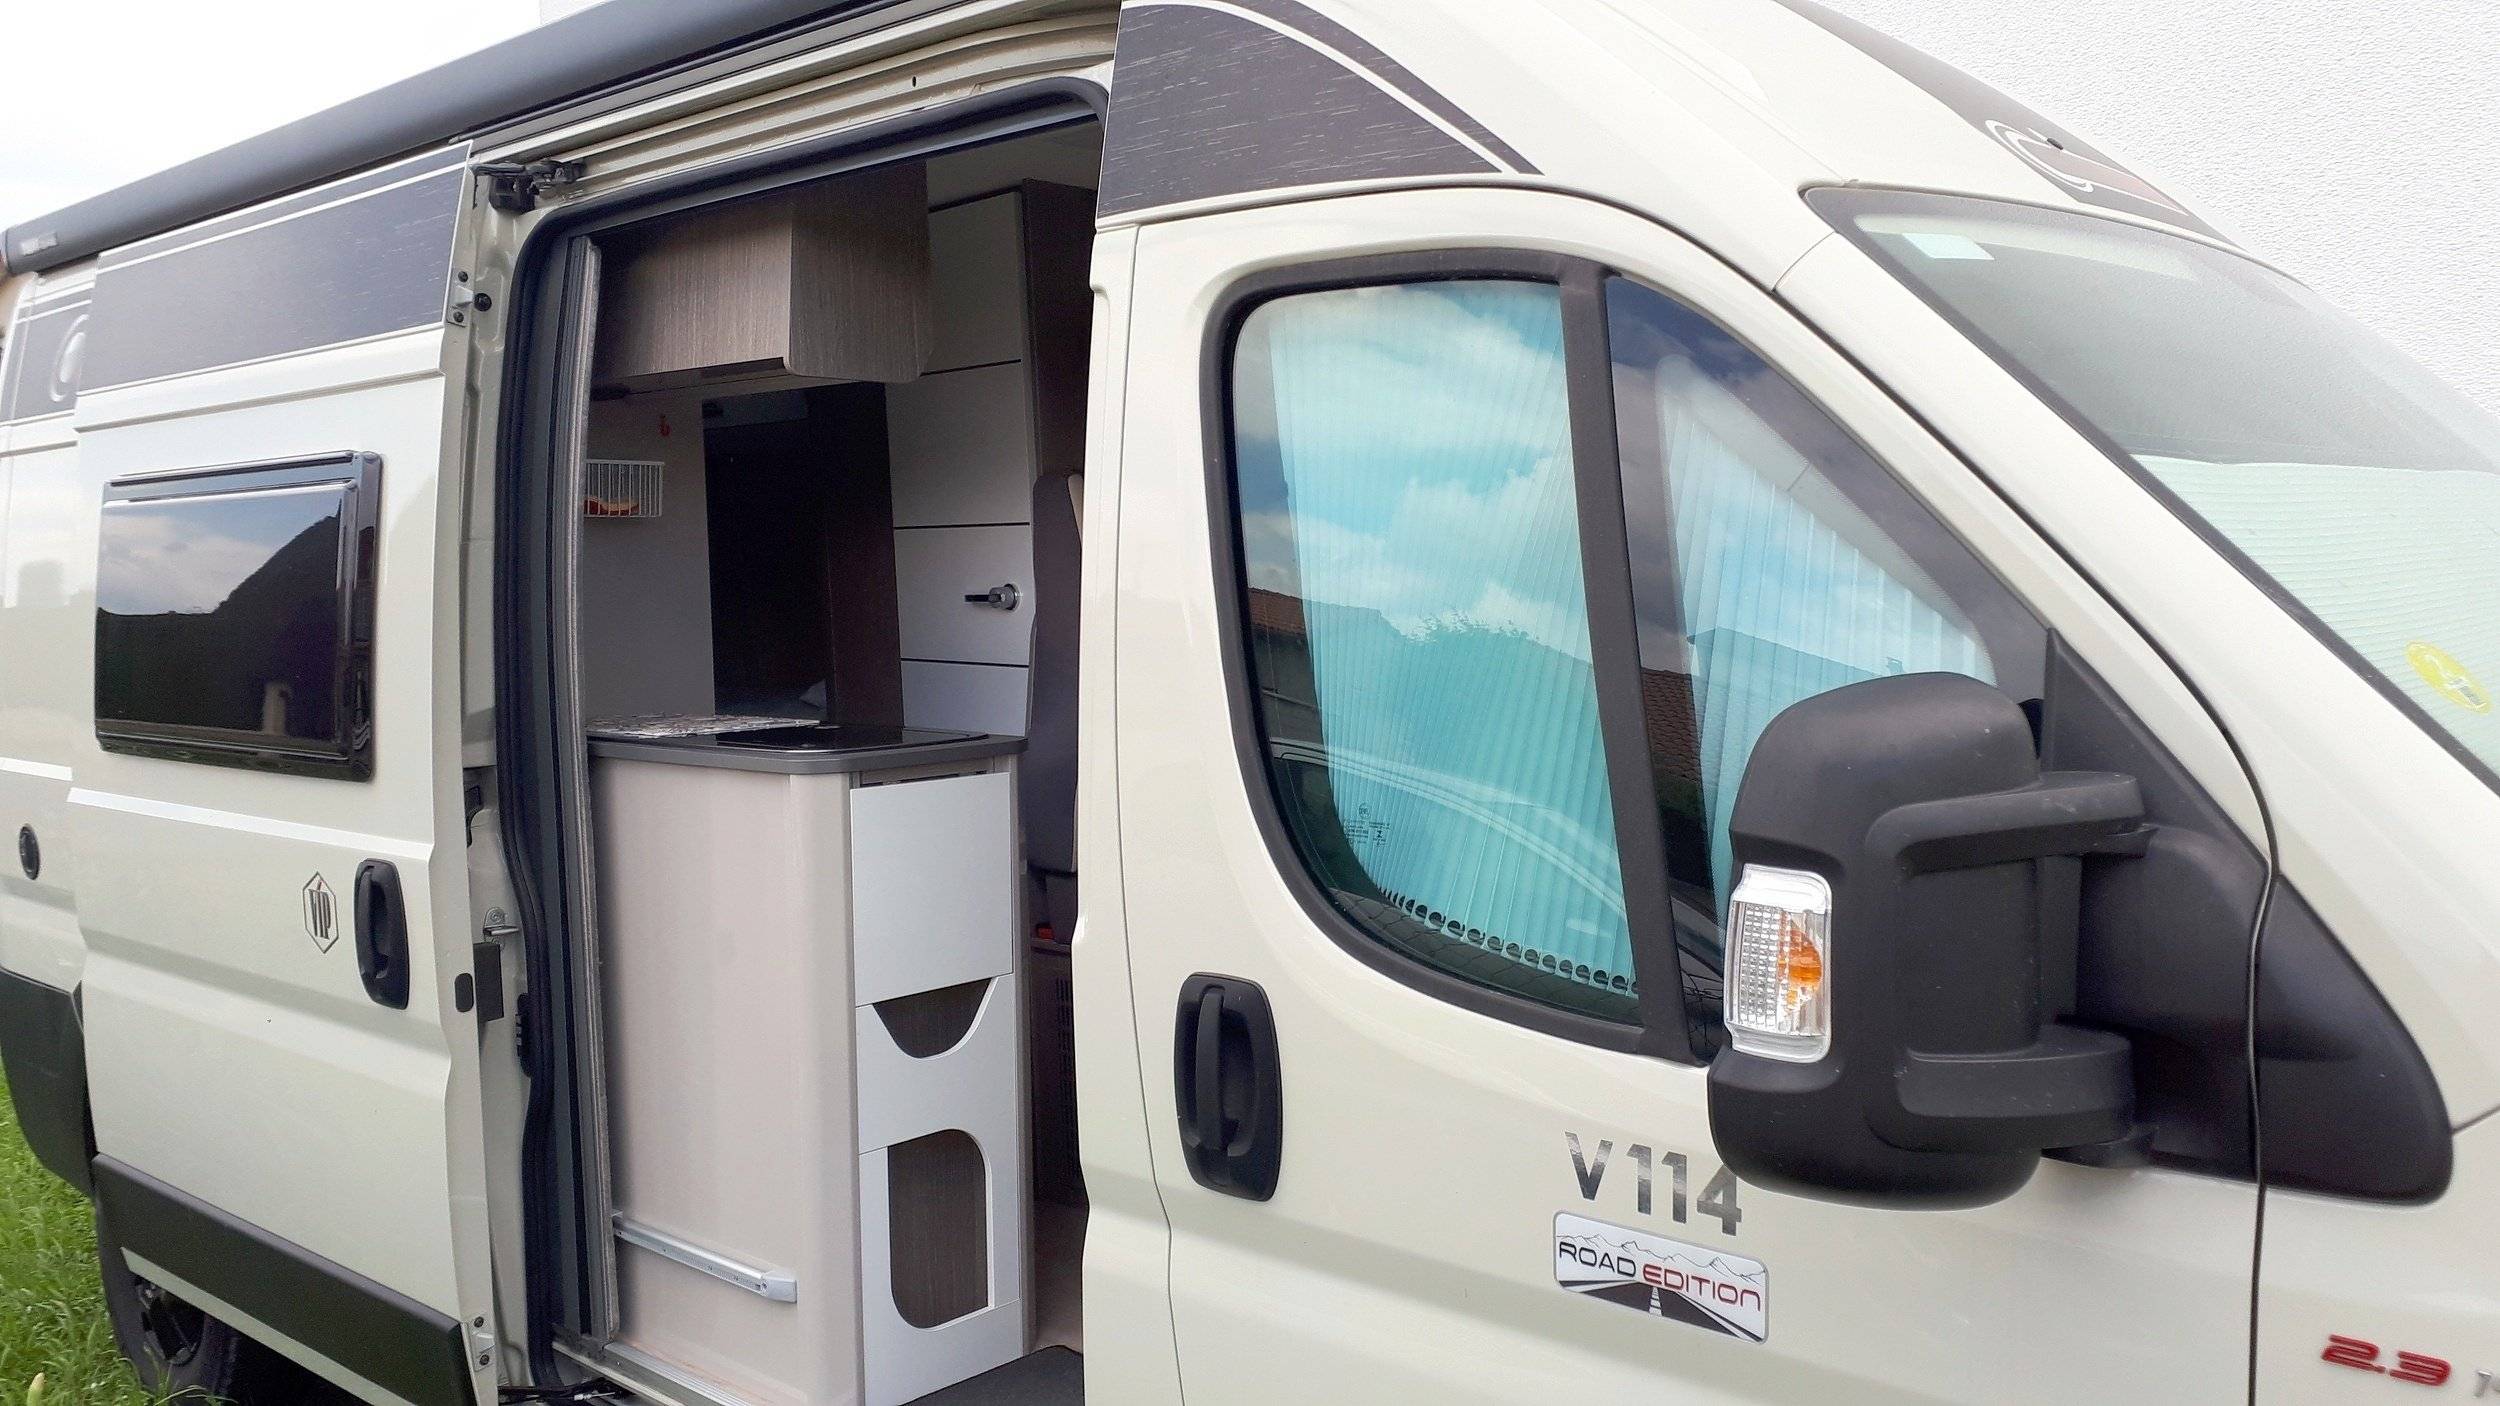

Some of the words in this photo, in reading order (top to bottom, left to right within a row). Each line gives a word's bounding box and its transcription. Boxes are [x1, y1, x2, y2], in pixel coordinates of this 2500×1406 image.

[1559, 1241, 1636, 1278] ROAD
[1643, 1262, 1761, 1312] EDITION
[2321, 1334, 2452, 1386] 2.3
